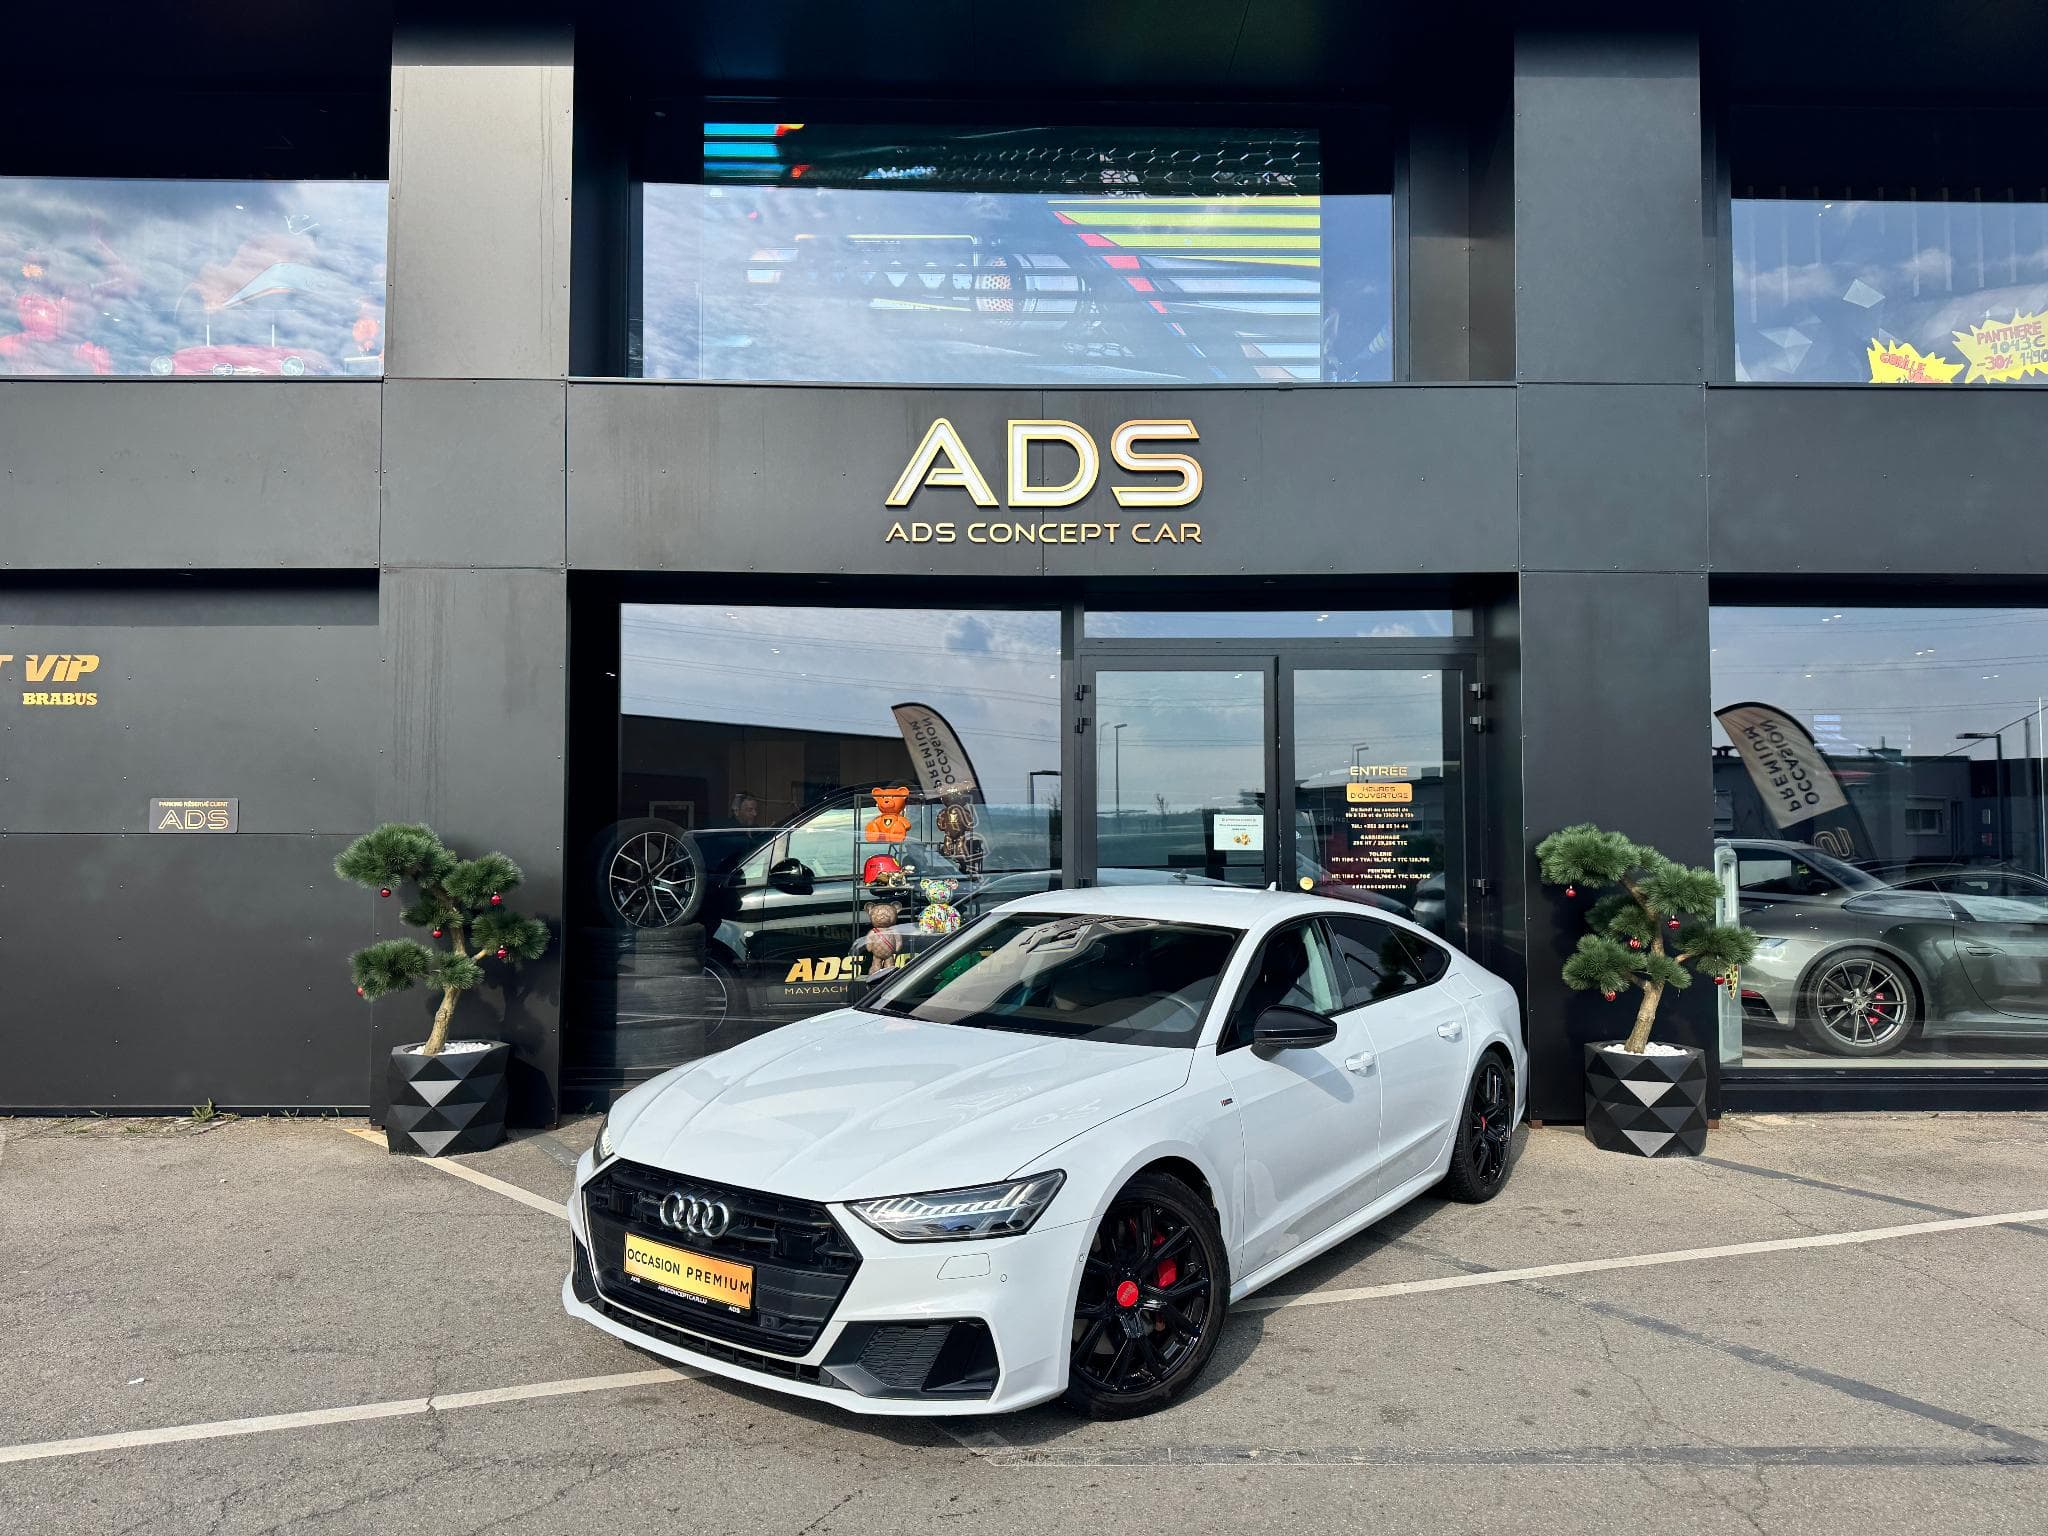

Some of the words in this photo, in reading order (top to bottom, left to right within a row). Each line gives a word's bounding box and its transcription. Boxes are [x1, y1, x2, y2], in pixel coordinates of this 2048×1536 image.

[884, 417, 1203, 507] ADS
[885, 522, 956, 543] ADS
[967, 522, 1120, 543] CONCEPT
[1131, 522, 1202, 543] CAR
[23, 692, 97, 705] BRABUS
[1350, 764, 1408, 776] ENTRÉE
[158, 810, 229, 829] ADS
[785, 956, 864, 982] ADS
[784, 985, 848, 995] MAYBACH
[627, 1249, 680, 1275] OCCASION
[686, 1267, 750, 1294] PREMIUM
[728, 1305, 741, 1314] ADS
